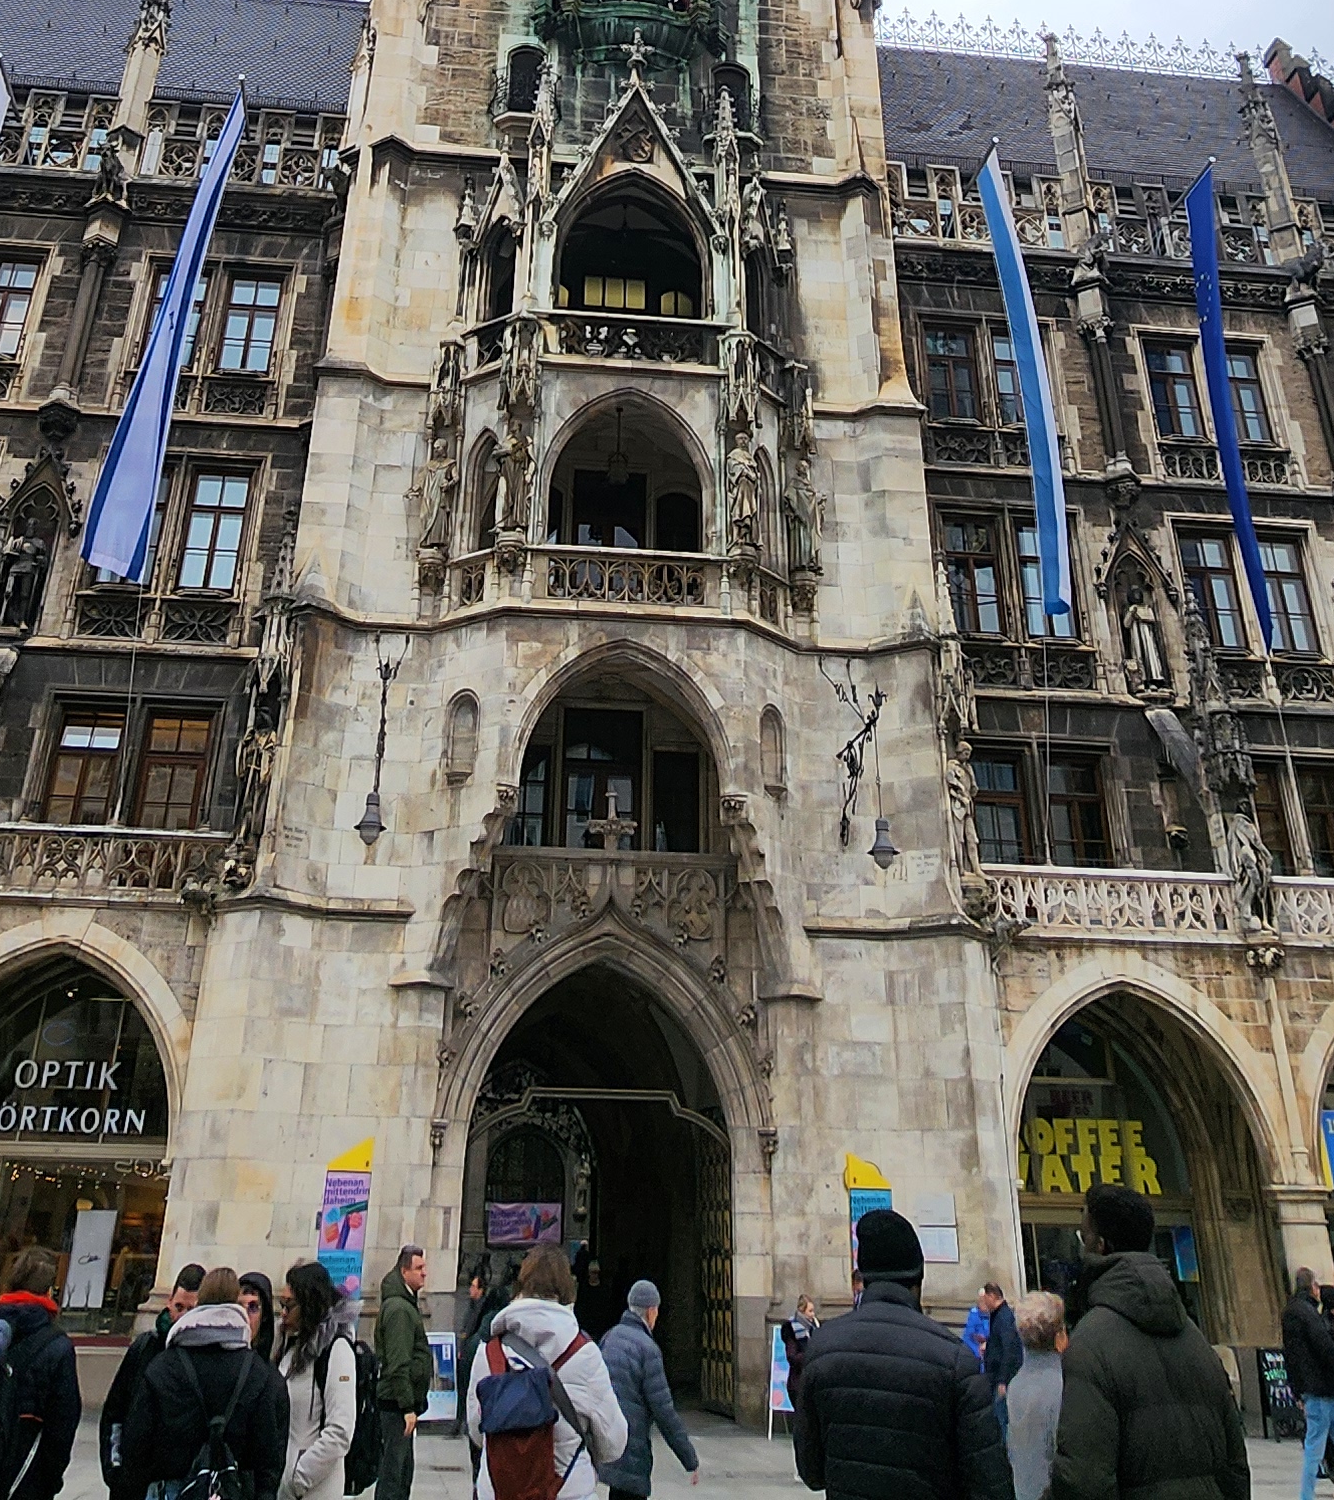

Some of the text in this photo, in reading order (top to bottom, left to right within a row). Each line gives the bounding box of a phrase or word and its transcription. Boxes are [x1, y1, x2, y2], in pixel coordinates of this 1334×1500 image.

[14, 1059, 122, 1091] OPTIK
[1019, 1117, 1146, 1157] OFFEE
[327, 1177, 365, 1188] Nebenan
[1019, 1153, 1163, 1195] ATER
